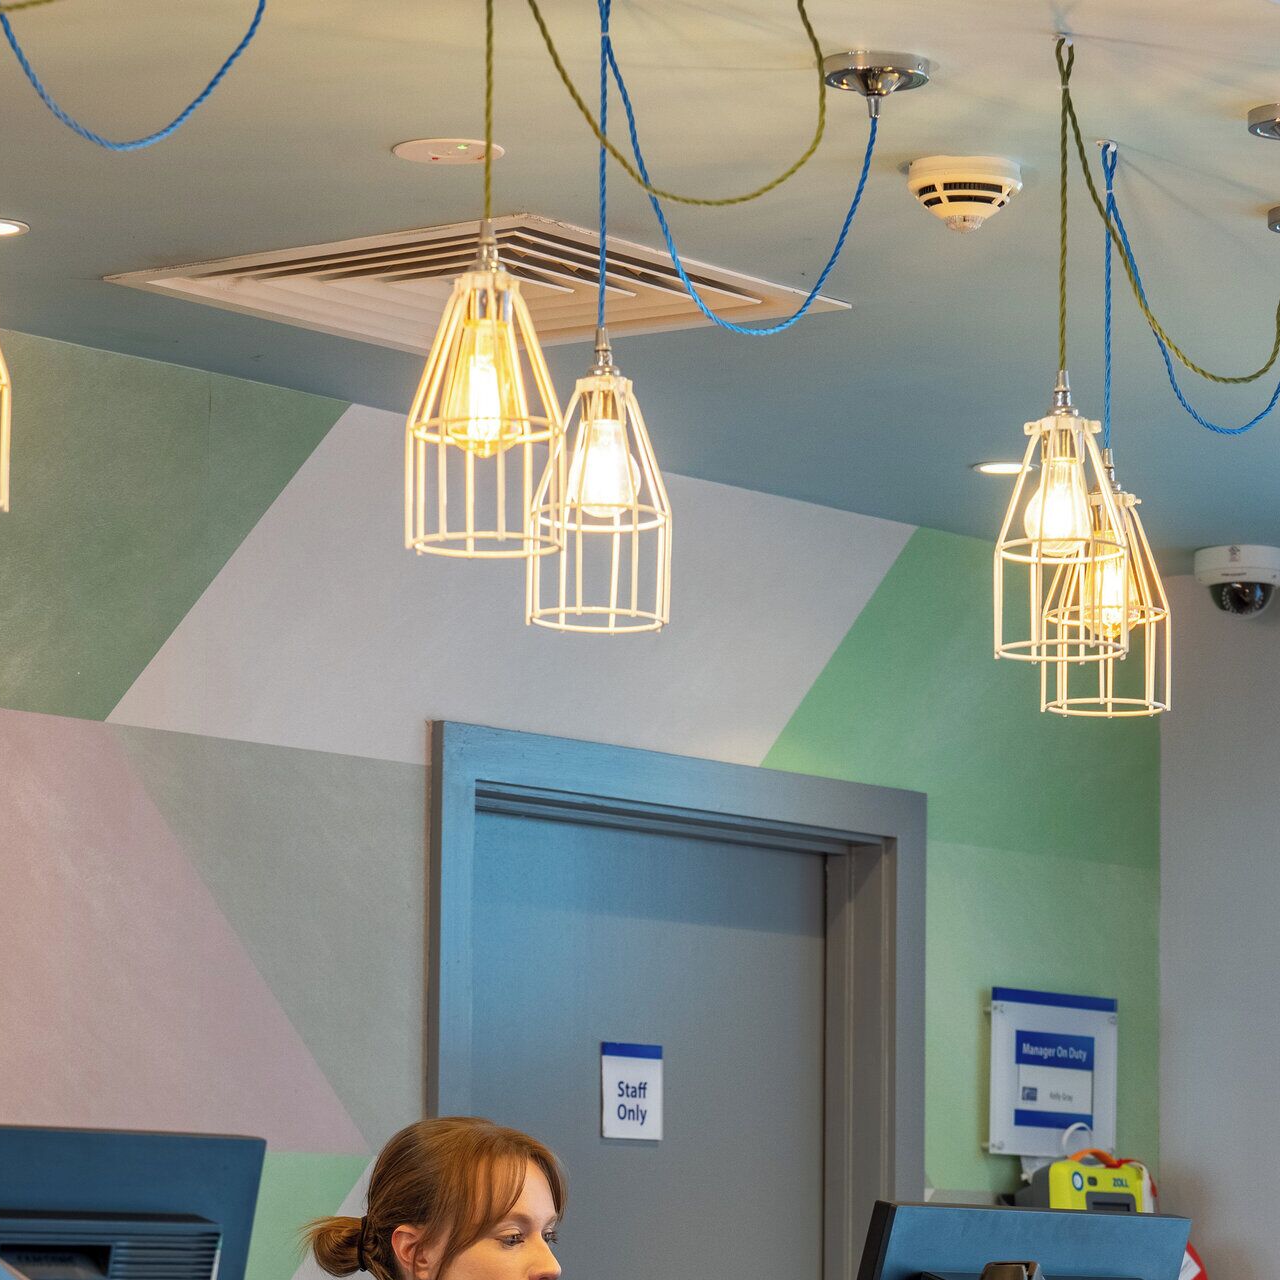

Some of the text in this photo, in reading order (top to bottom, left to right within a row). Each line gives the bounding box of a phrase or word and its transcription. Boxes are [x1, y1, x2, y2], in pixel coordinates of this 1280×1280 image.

[1022, 1042, 1087, 1063] Manager On Duty
[617, 1081, 648, 1099] Staff
[617, 1103, 648, 1126] Only
[1112, 1177, 1129, 1188] ZOLL
